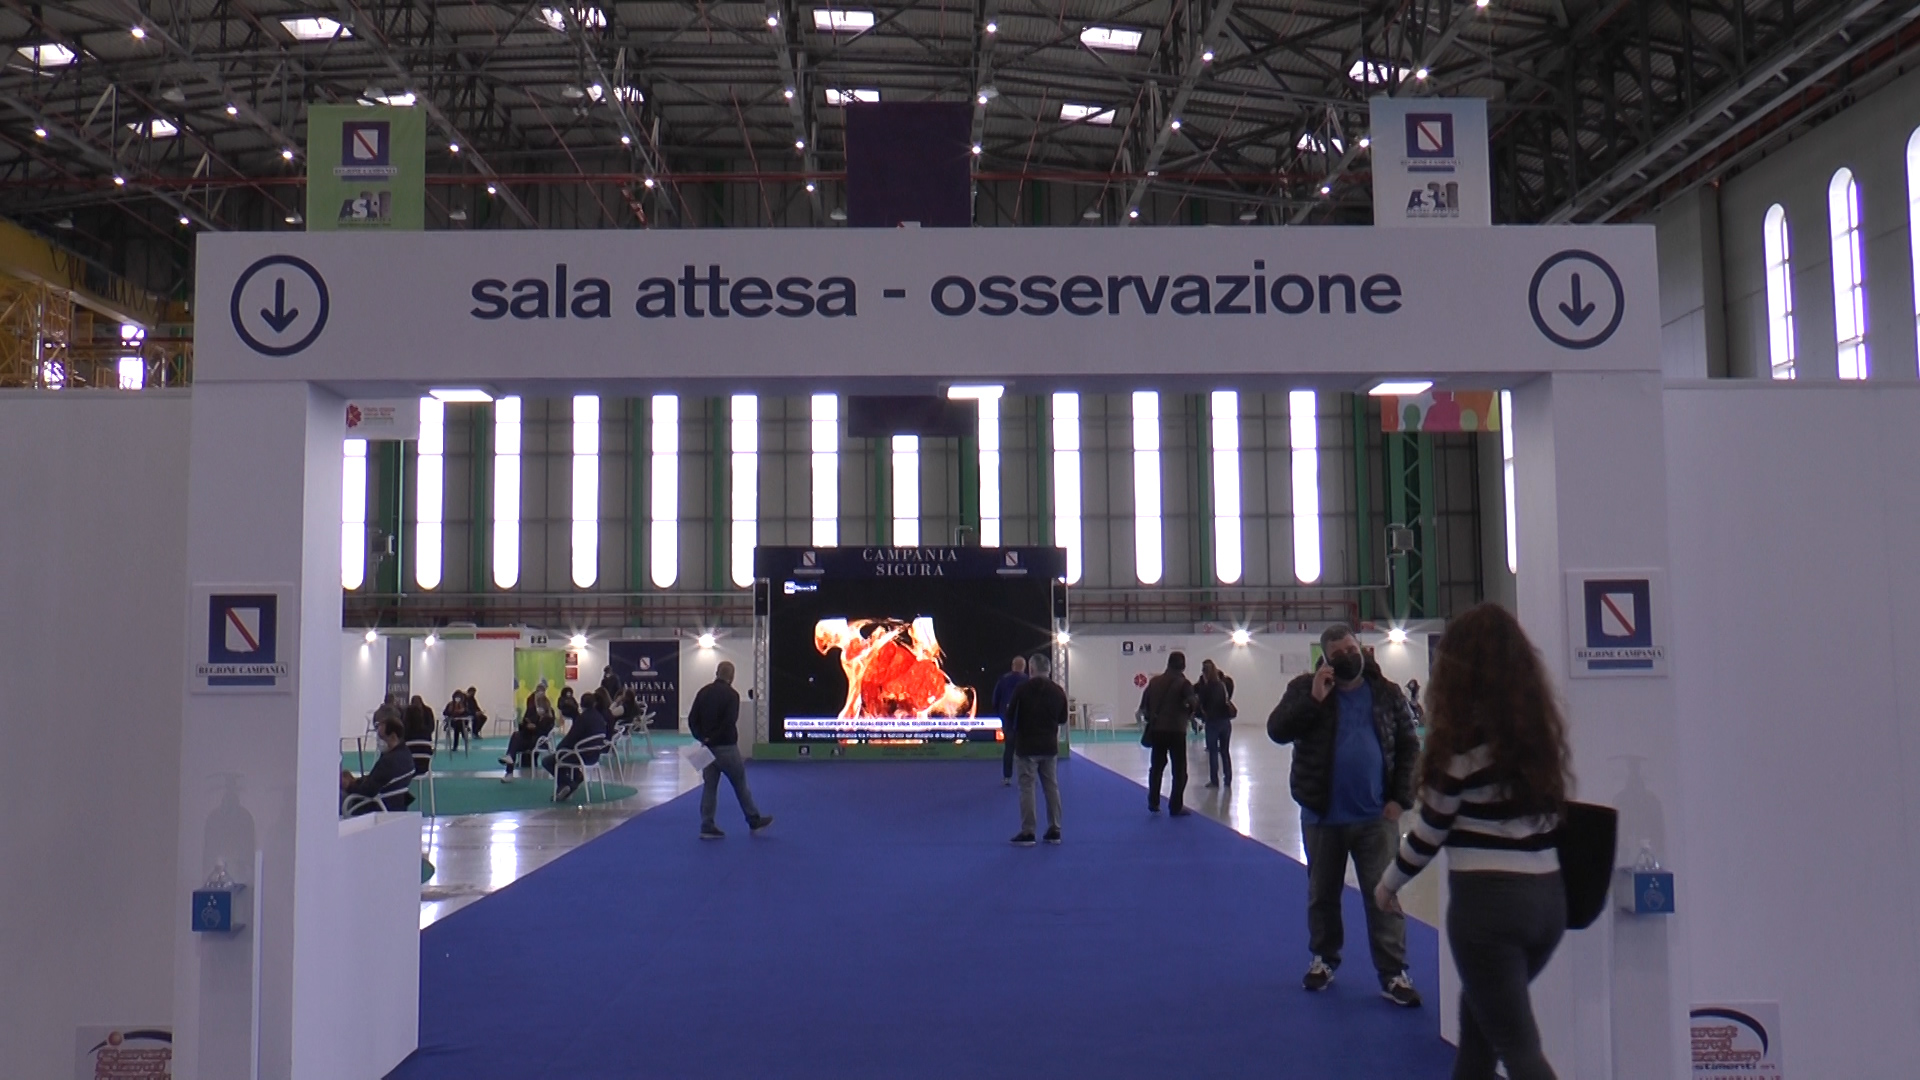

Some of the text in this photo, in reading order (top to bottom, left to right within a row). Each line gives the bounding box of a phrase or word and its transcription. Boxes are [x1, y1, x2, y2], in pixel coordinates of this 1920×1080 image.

[470, 259, 1403, 319] sala attesa - osservazione
[862, 548, 958, 561] CAMPANIA
[875, 563, 944, 577] SICURA
[1617, 648, 1662, 658] CAMPANIA
[239, 664, 286, 674] CAMPANIA
[623, 681, 675, 690] AMPANIA
